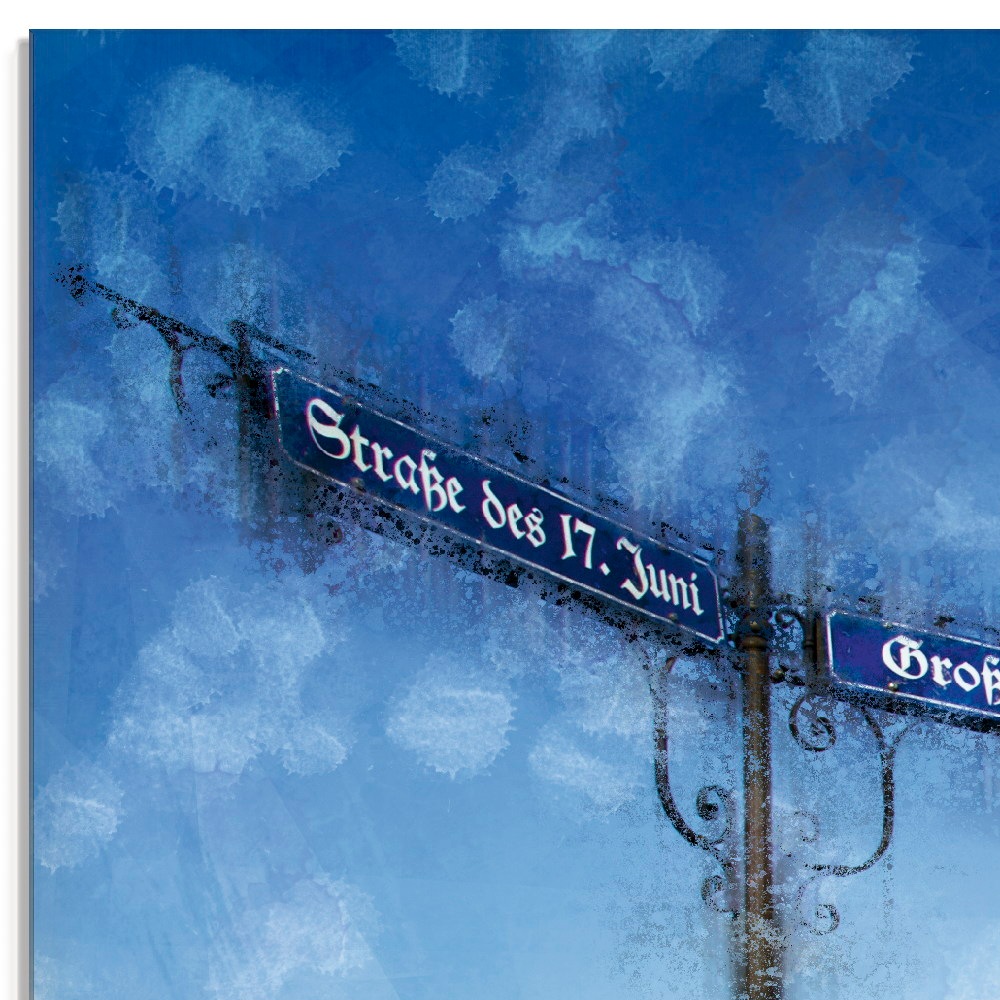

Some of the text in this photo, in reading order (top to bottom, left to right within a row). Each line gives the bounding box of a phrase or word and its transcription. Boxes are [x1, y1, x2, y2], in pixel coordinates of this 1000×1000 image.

[304, 397, 705, 616] Straße des 17. Juni
